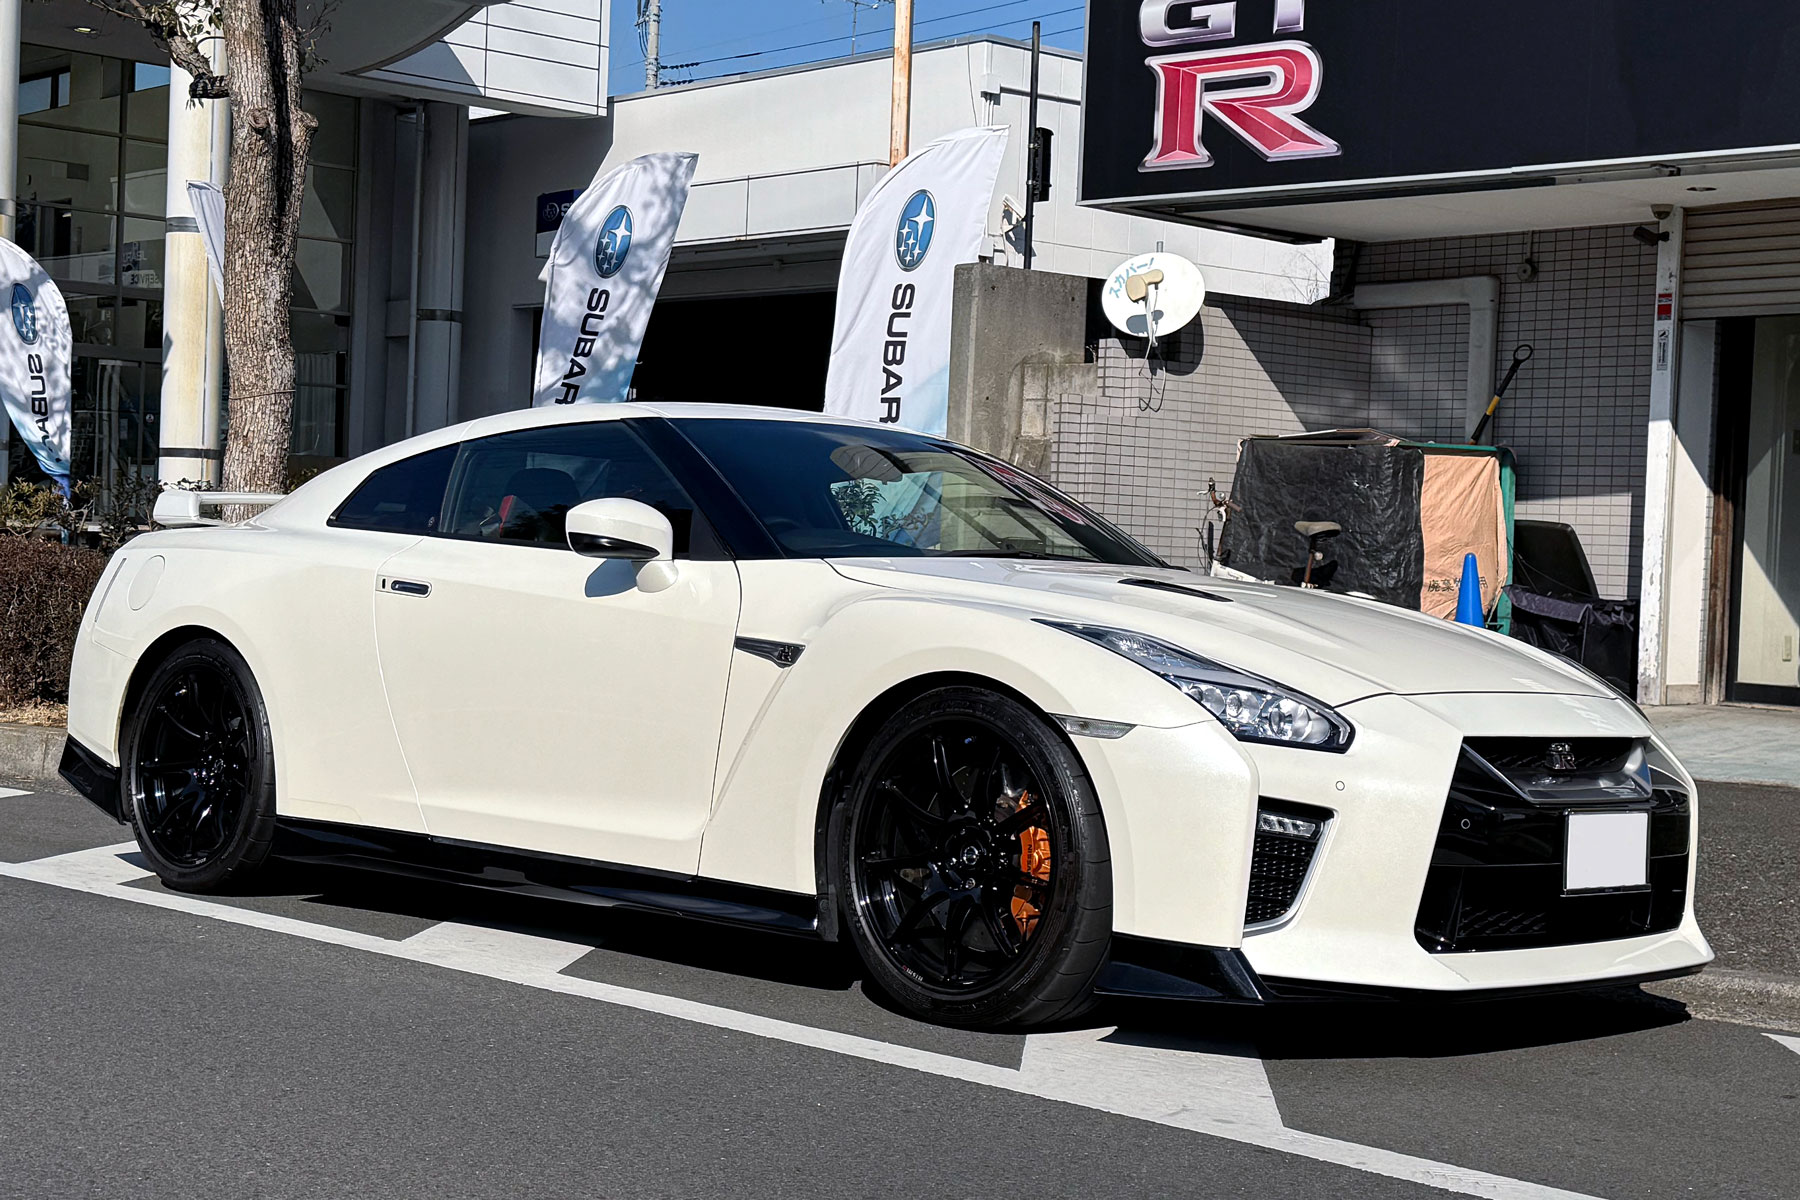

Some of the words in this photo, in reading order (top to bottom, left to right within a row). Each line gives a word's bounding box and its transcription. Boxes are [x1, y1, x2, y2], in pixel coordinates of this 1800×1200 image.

[1137, 40, 1342, 172] R
[554, 287, 610, 405] SUBAR
[879, 283, 916, 424] SUBAR
